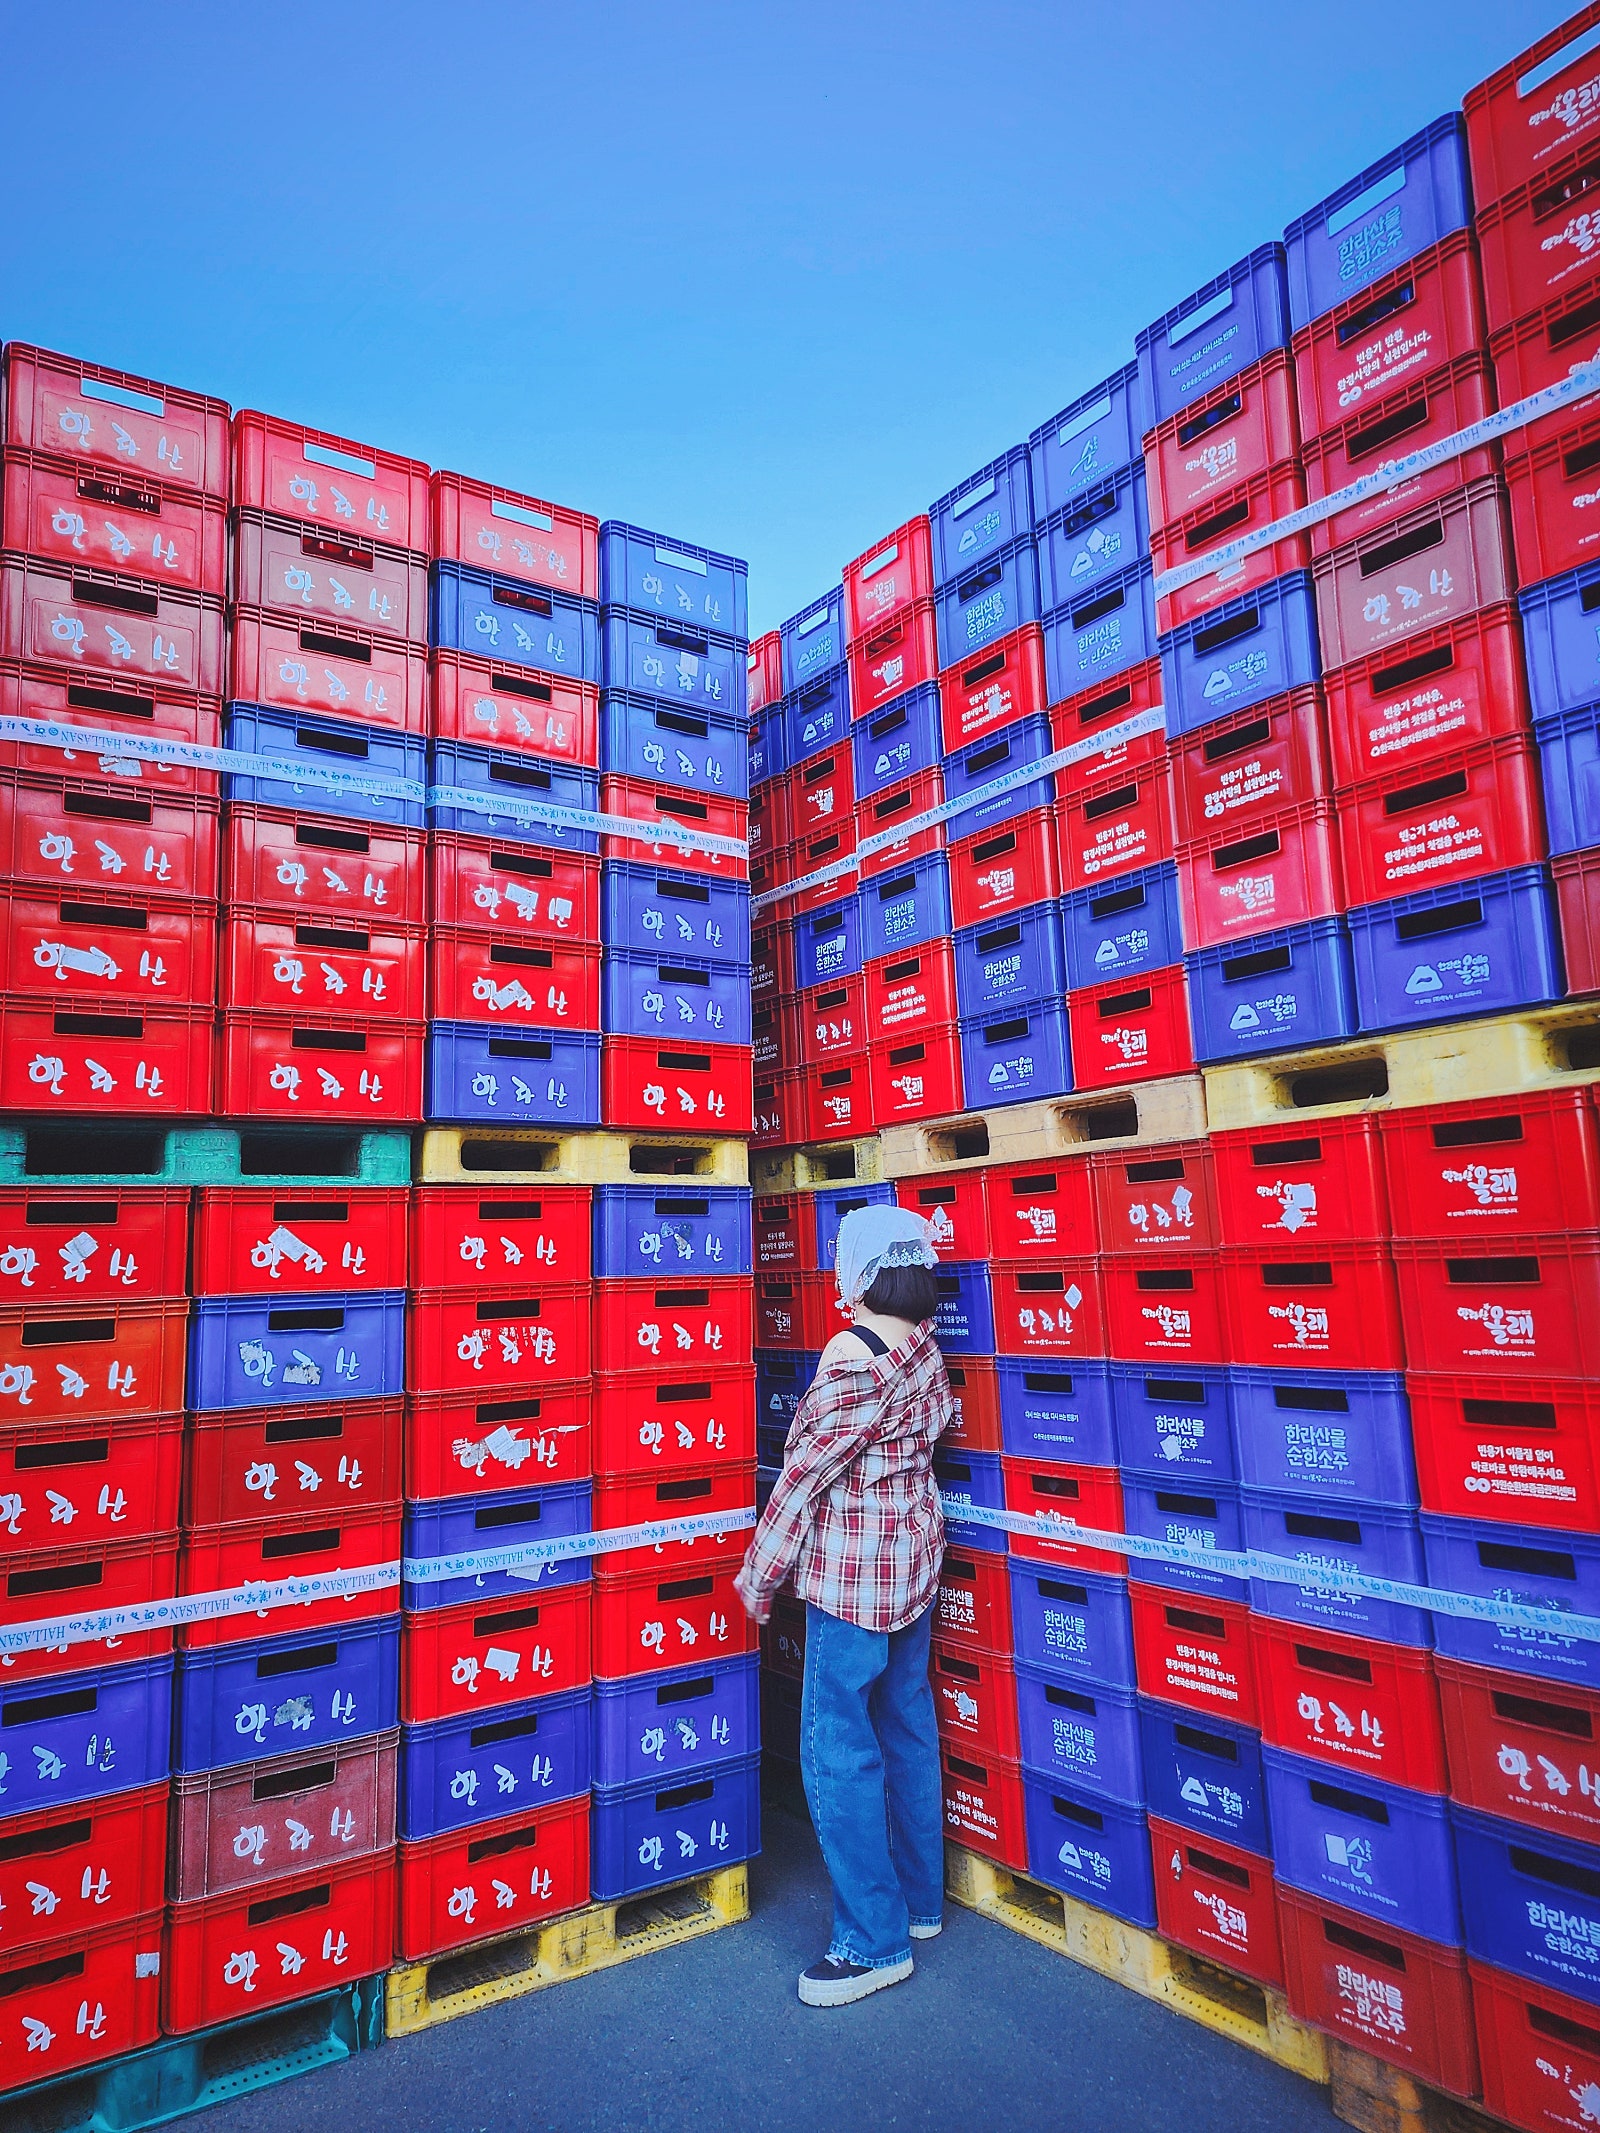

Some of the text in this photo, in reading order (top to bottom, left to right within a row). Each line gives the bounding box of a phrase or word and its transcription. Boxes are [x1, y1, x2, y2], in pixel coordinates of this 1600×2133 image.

[59, 406, 183, 471] 한라산
[1417, 428, 1481, 465] HALLASAN
[289, 474, 389, 530] 한라산
[52, 508, 179, 568] 한라산
[284, 565, 391, 619] 한라산
[642, 572, 721, 621] 한라산
[1363, 569, 1453, 625] 한라산
[51, 613, 179, 670] 한라산
[474, 610, 565, 662] 한라산
[1243, 652, 1268, 680] 올래
[279, 658, 388, 711] 한라산
[59, 729, 269, 772] HALLASAN HALLASAN
[642, 741, 723, 784] 한라산
[485, 799, 529, 816] HALLASAN
[595, 818, 636, 834] HALLASAN
[40, 831, 171, 881] 한라산
[277, 859, 387, 905] 한라산
[1239, 876, 1275, 909] 올래
[642, 907, 722, 947] 한라산
[1127, 929, 1149, 954] 올래
[273, 956, 387, 1000] 한라산
[983, 954, 1022, 980] 한라산물
[1456, 954, 1490, 985] 올래
[643, 990, 723, 1028] 한라산
[1269, 994, 1297, 1022] 올래
[1118, 1028, 1148, 1059] 올래
[28, 1053, 163, 1096] 한라산
[269, 1063, 382, 1101] 한라산
[471, 1072, 568, 1108] 한라산
[643, 1083, 725, 1117] 한라산
[1467, 1166, 1517, 1204] 올래
[1031, 1208, 1056, 1235] 올래
[459, 1235, 557, 1269] 한라산
[637, 1321, 722, 1354] 한라산
[1018, 1308, 1074, 1335] 한라산
[1159, 1306, 1191, 1337] 올래
[1483, 1305, 1534, 1345] 올래
[0, 1362, 136, 1405] 한라산
[639, 1418, 726, 1454] 한라산
[1155, 1414, 1206, 1436] 한라산물
[1285, 1424, 1347, 1449] 한라산물
[1286, 1445, 1349, 1471] 순한소주
[1471, 1460, 1508, 1475] 바로바로
[244, 1456, 363, 1500] 한라산
[596, 1532, 641, 1549] HALLASAN
[476, 1550, 524, 1570] HALLASAN
[1258, 1560, 1307, 1582] HALLASAN
[321, 1573, 376, 1593] HALLASAN
[939, 1586, 974, 1608] 한라산물
[1395, 1586, 1457, 1611] HALLASAN
[169, 1598, 230, 1618] HALLASAN
[1043, 1609, 1087, 1635] 한라산물
[640, 1612, 728, 1654] 한라산
[1045, 1628, 1088, 1653] 순한소주
[640, 1715, 730, 1761] 한라산
[1052, 1717, 1096, 1748] 한라산물
[1297, 1692, 1384, 1748] 한라산
[1053, 1736, 1098, 1767] 순한소주
[450, 1754, 553, 1806] 한라산
[1218, 1786, 1243, 1814] 올래
[234, 1807, 356, 1864] 한라산
[638, 1820, 728, 1871] 한라산
[1090, 1851, 1112, 1880] 올래
[448, 1867, 552, 1922] 한라산
[1212, 1896, 1247, 1937] 올래
[224, 1929, 348, 1991] 한라산
[1544, 1932, 1600, 1964] 순한소주
[1335, 1963, 1404, 2011] 한라산물
